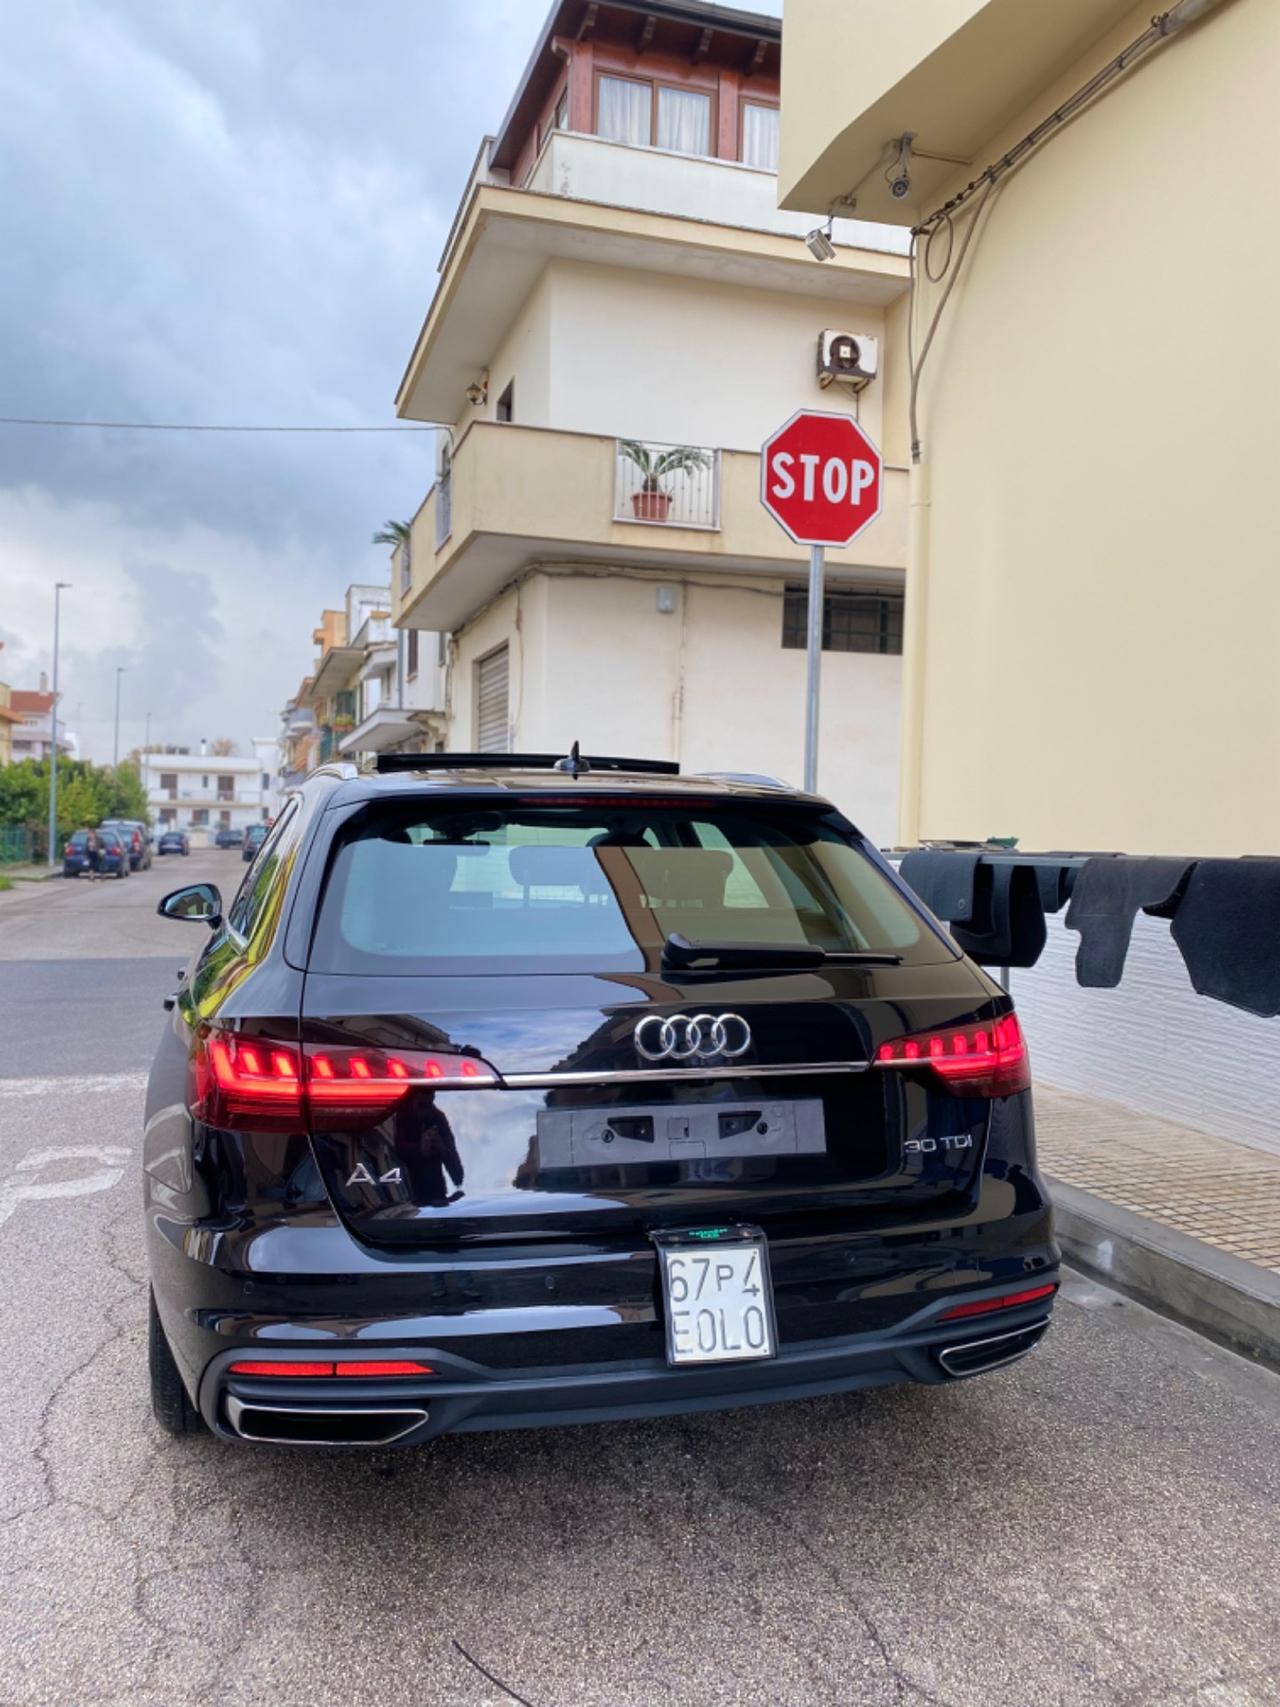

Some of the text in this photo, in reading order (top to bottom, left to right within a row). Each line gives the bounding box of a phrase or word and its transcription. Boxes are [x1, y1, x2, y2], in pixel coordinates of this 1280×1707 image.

[772, 452, 874, 505] STOP
[904, 1134, 972, 1153] 30 TDI
[345, 1163, 402, 1187] A4
